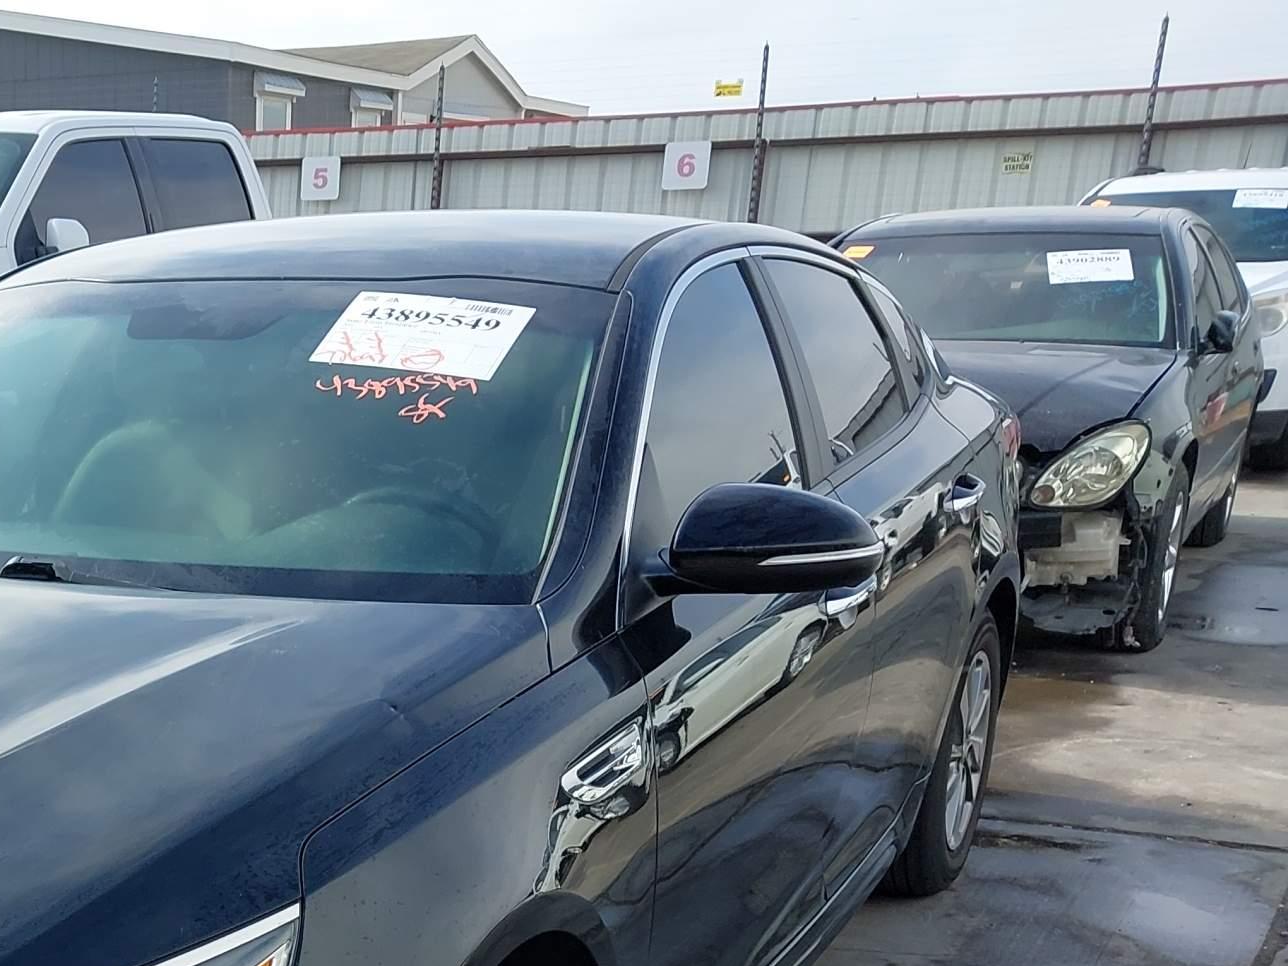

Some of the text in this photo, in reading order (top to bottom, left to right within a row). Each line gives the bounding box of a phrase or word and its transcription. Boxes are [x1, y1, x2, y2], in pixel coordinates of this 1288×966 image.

[677, 153, 696, 177] 6
[313, 167, 328, 189] 5
[361, 306, 502, 331] 43895549
[315, 373, 478, 399] 43895549
